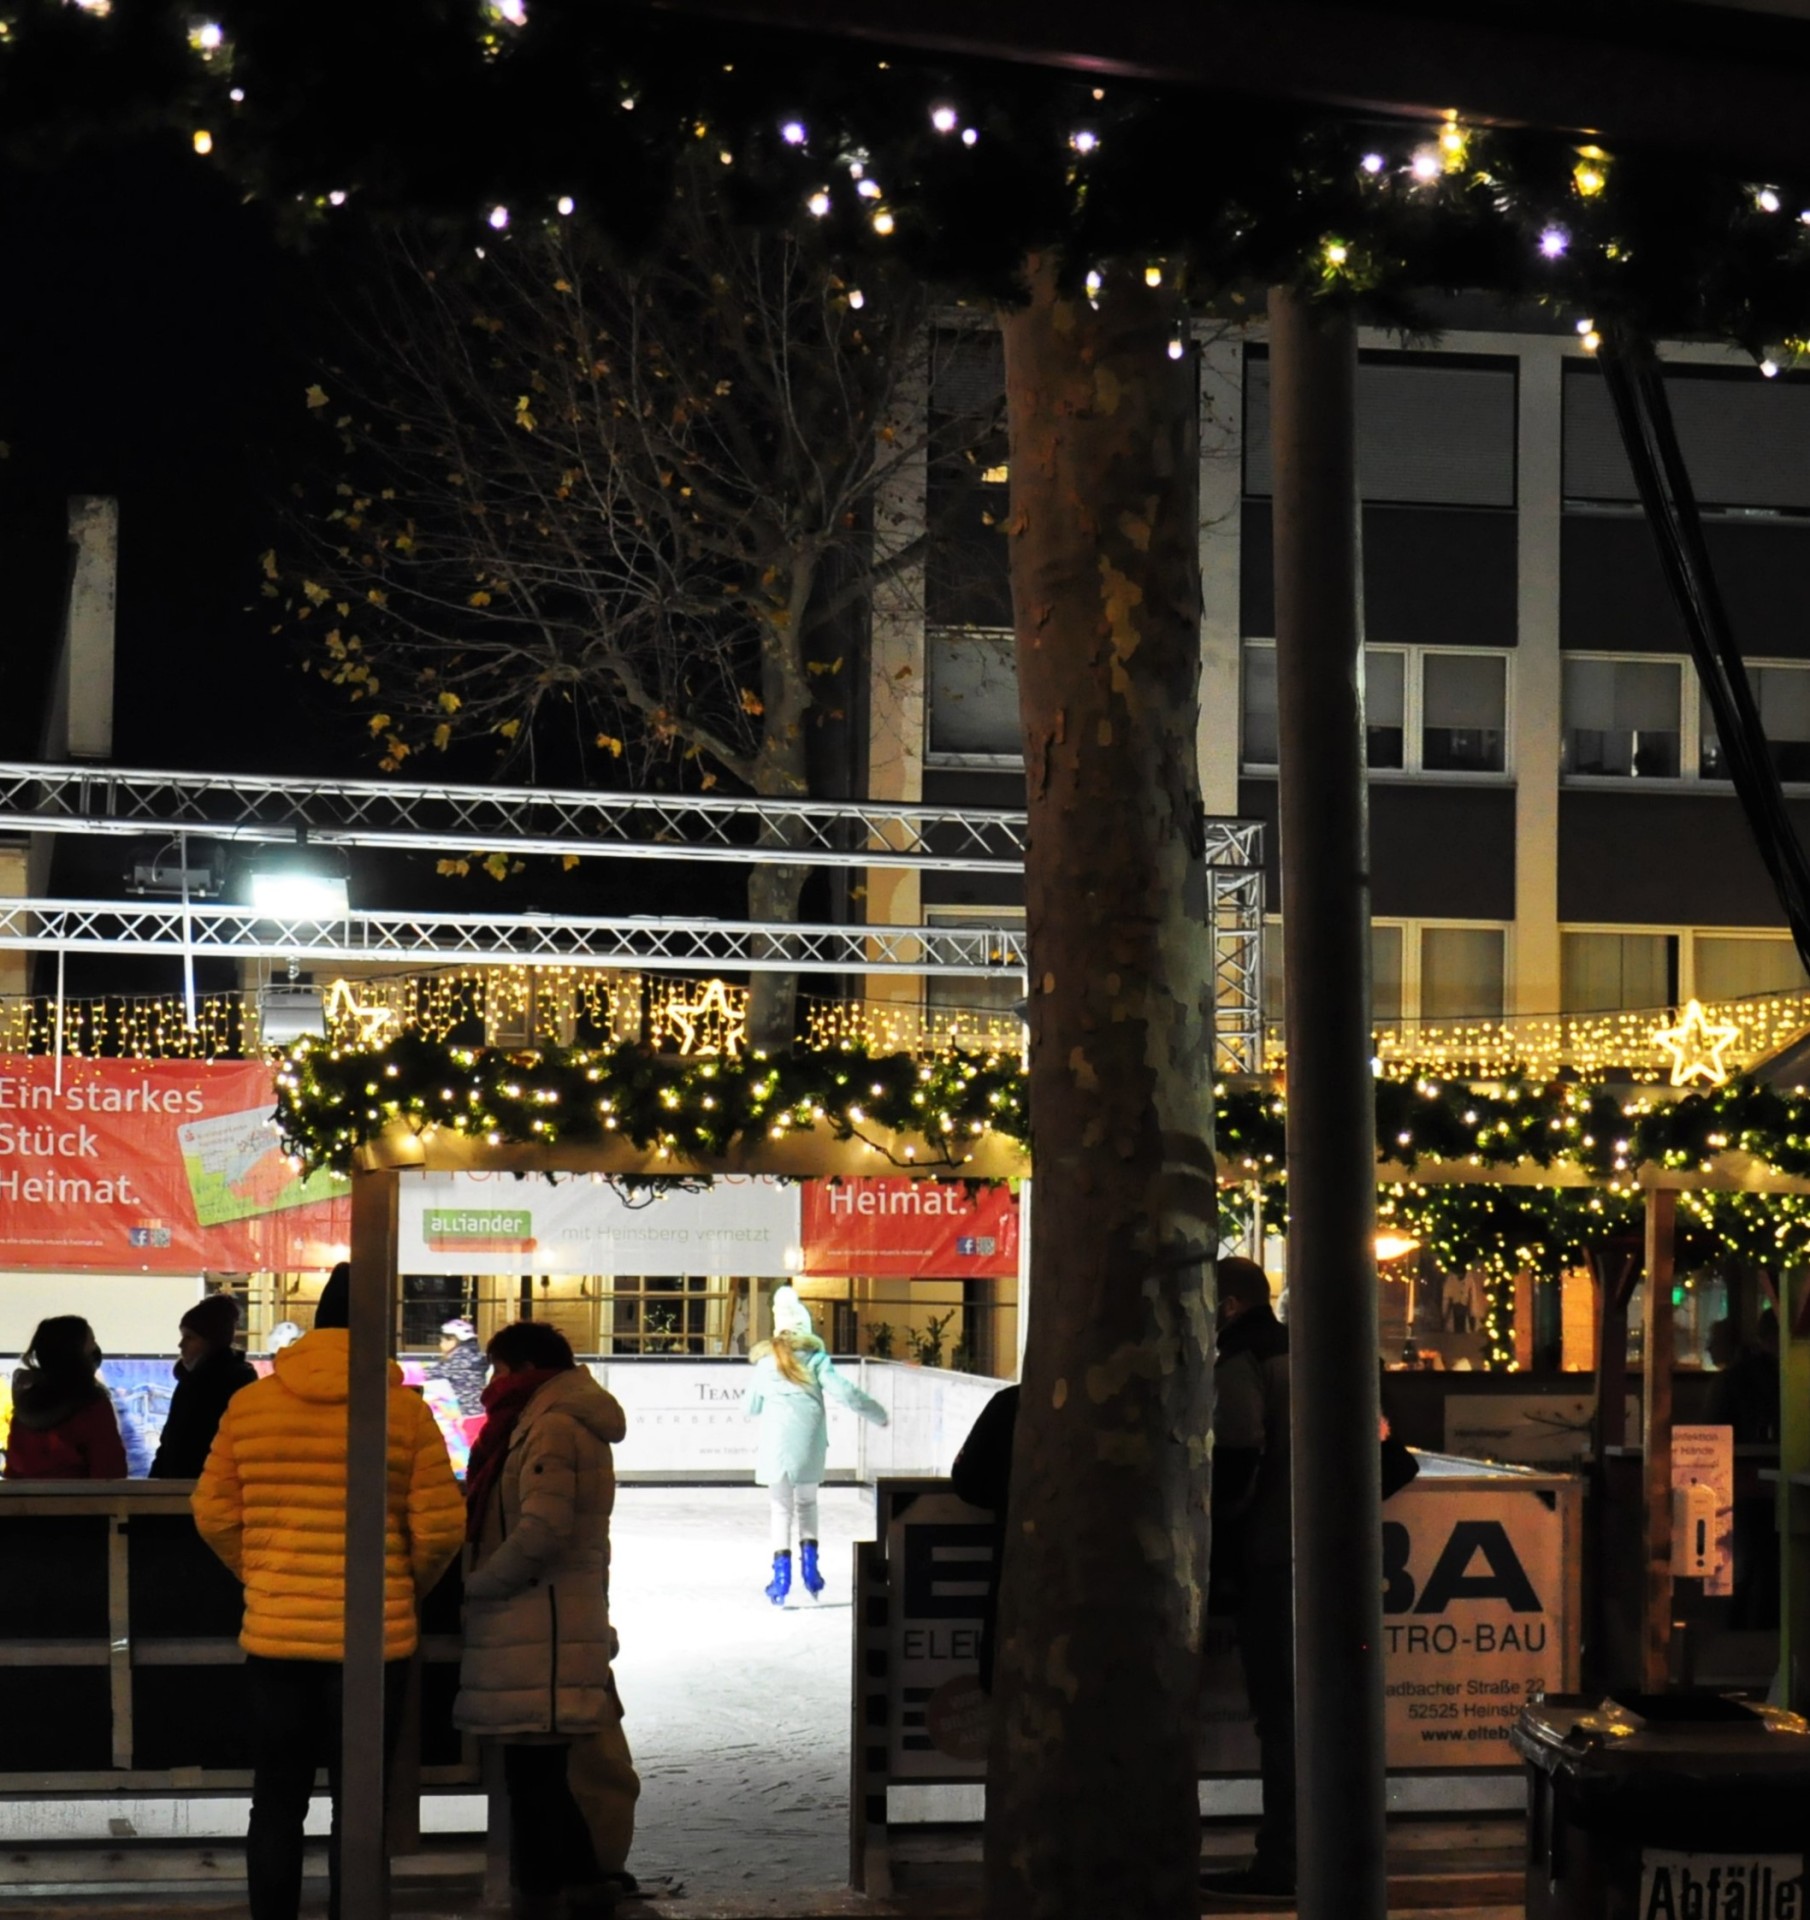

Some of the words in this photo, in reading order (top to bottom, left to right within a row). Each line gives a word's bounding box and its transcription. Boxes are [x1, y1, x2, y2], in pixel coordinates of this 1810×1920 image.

[0, 1076, 52, 1110] Ein
[66, 1080, 204, 1114] starkes
[0, 1124, 98, 1158] Stück
[0, 1170, 140, 1205] Heimat.
[829, 1183, 967, 1215] Heimat.
[431, 1213, 523, 1233] alliander
[561, 1225, 591, 1240] mit
[597, 1225, 689, 1244] Heinsberg
[695, 1227, 770, 1242] vernetzt
[904, 1630, 980, 1660] ELE
[1385, 1624, 1547, 1654] TRO-BAU
[1385, 1681, 1462, 1696] adbacher
[1467, 1679, 1520, 1695] Straße
[1525, 1678, 1546, 1694] 22
[1408, 1704, 1458, 1719] 52525
[1421, 1725, 1510, 1741] www.elteb
[1647, 1863, 1796, 1920] Abfälle
